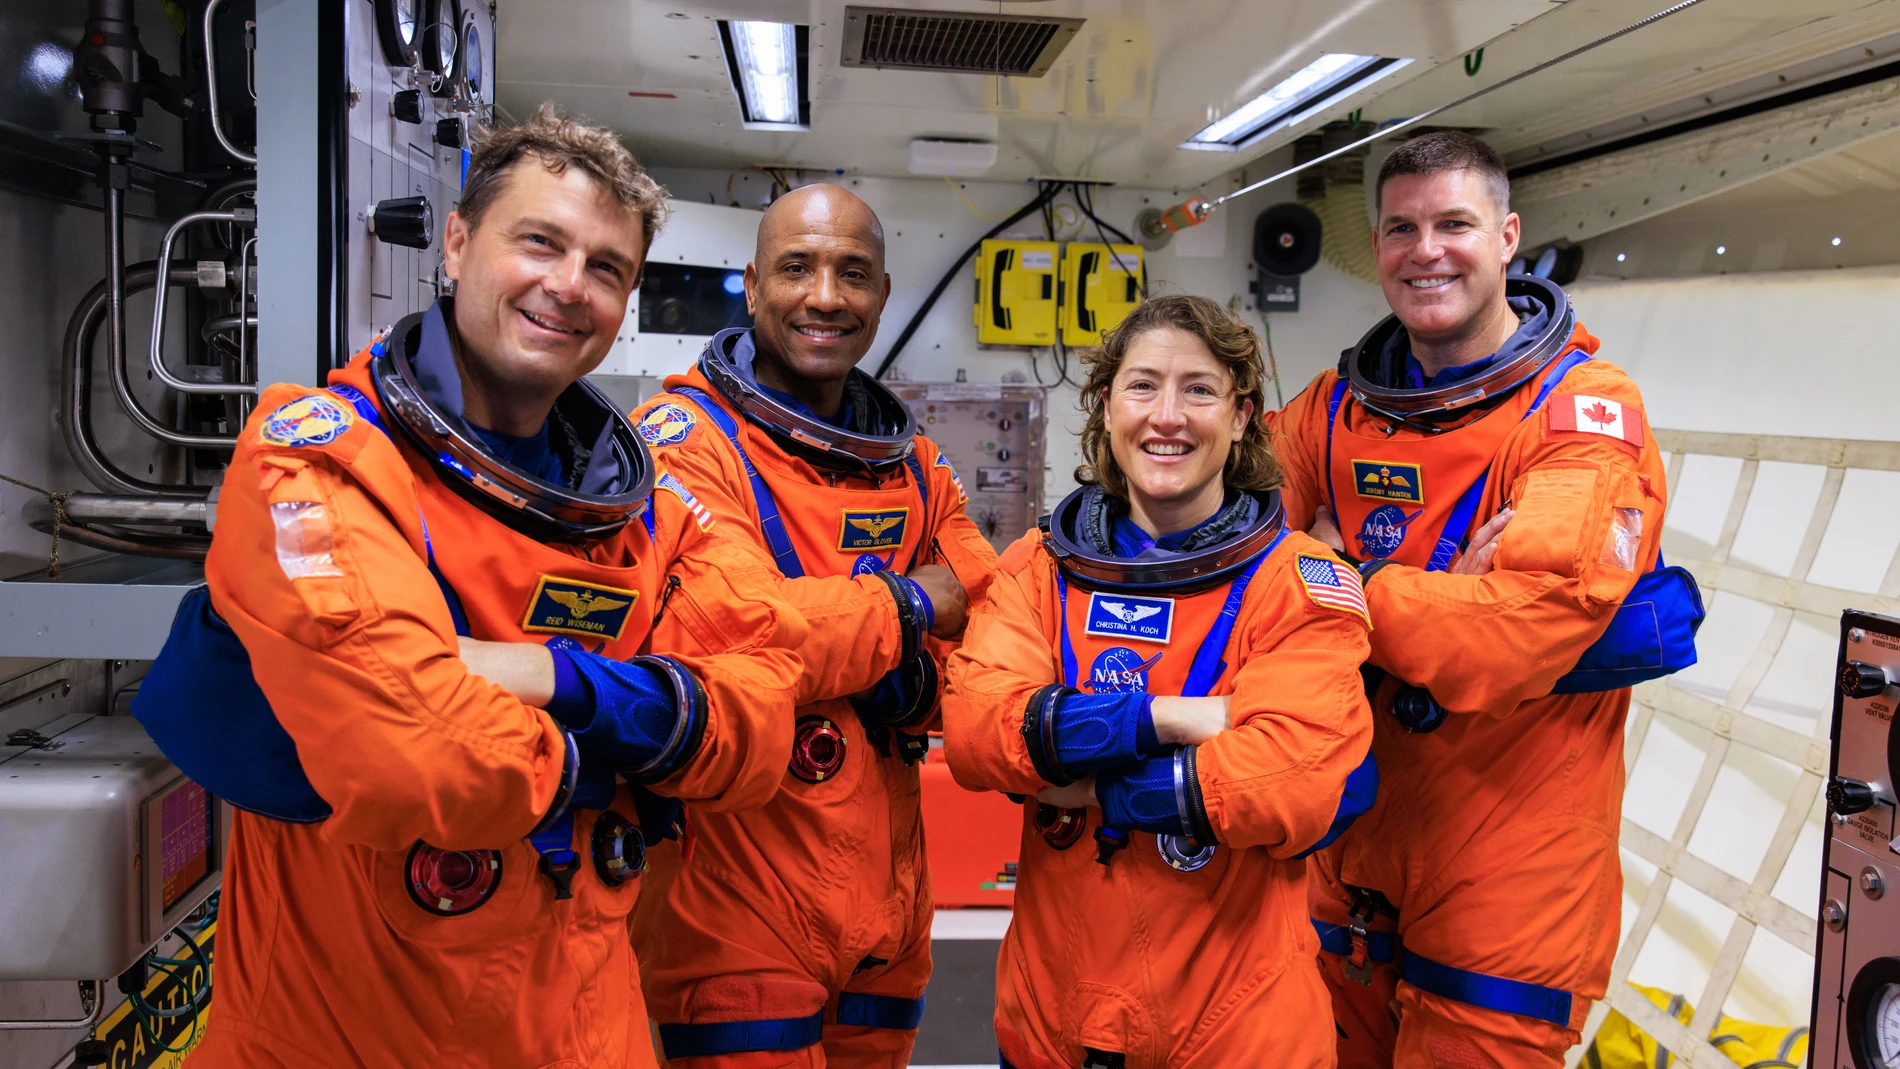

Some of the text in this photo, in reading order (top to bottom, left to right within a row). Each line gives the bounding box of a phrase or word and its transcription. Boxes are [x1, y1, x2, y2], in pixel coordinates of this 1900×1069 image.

[1365, 487, 1412, 499] JEREMY HANSEN
[1364, 522, 1402, 540] NASA
[873, 537, 893, 545] GLOVER
[545, 616, 606, 632] REID WISEMAN
[1095, 621, 1159, 635] CHRISTINA H. KOCH
[1094, 668, 1144, 686] NASA
[1865, 707, 1878, 717] VENT
[1847, 818, 1889, 840] GAUGE ISOLATION
[1859, 831, 1875, 843] VALVE
